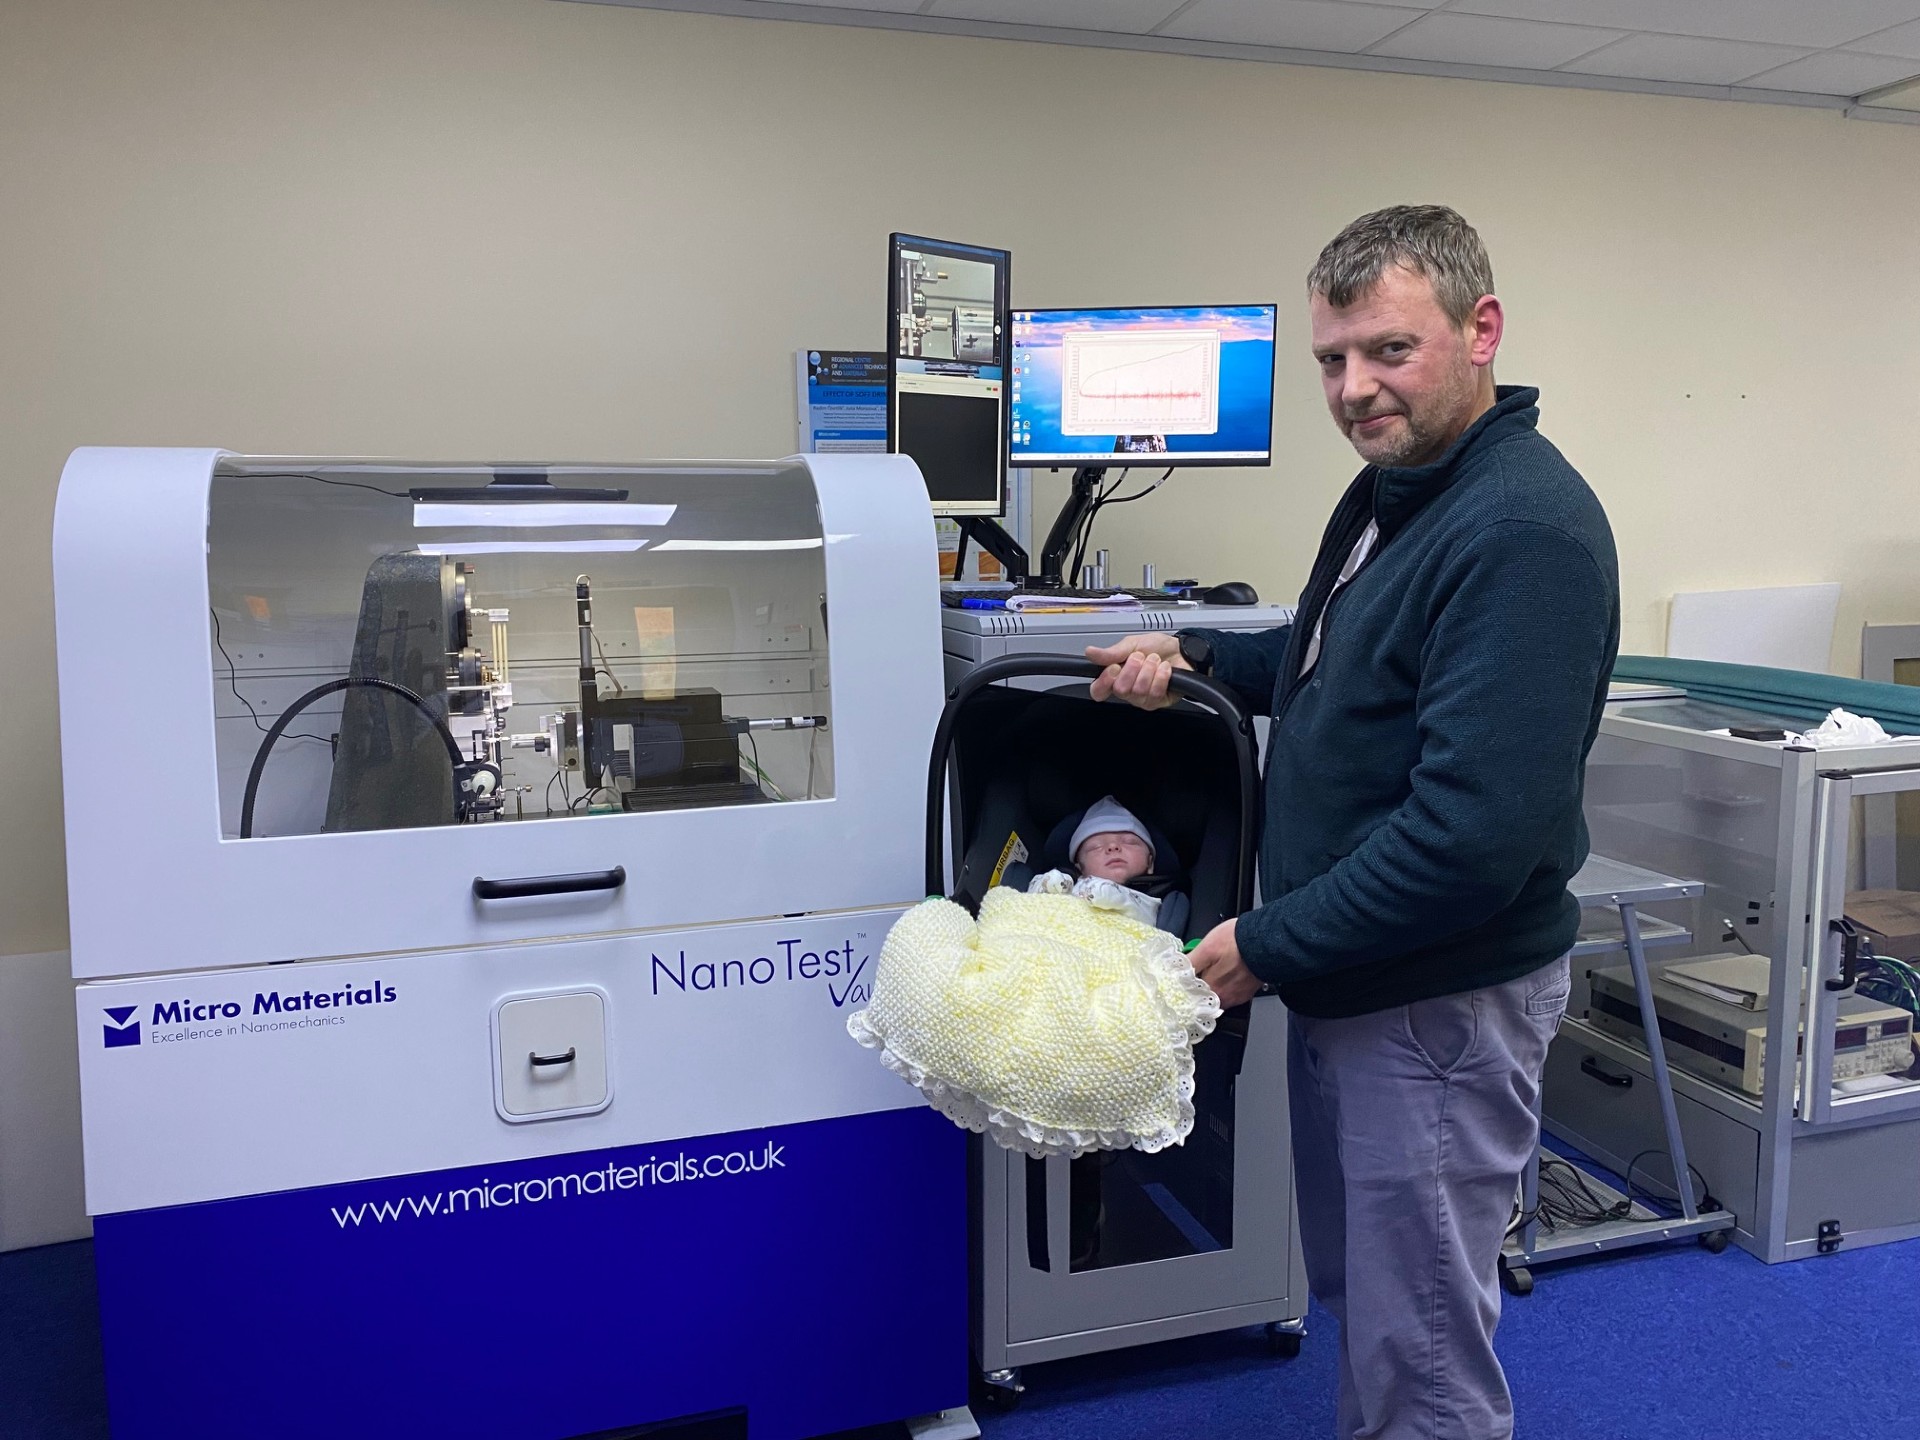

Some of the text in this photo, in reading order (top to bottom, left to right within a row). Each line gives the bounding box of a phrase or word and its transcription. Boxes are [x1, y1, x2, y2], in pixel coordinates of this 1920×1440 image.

[996, 839, 1015, 876] AIRBAG
[651, 938, 854, 995] NanoTest
[152, 980, 398, 1026] Micro Materials
[152, 1014, 346, 1044] Excellence in Nanomechanics
[331, 1140, 786, 1229] www.micromaterials.co.uk
